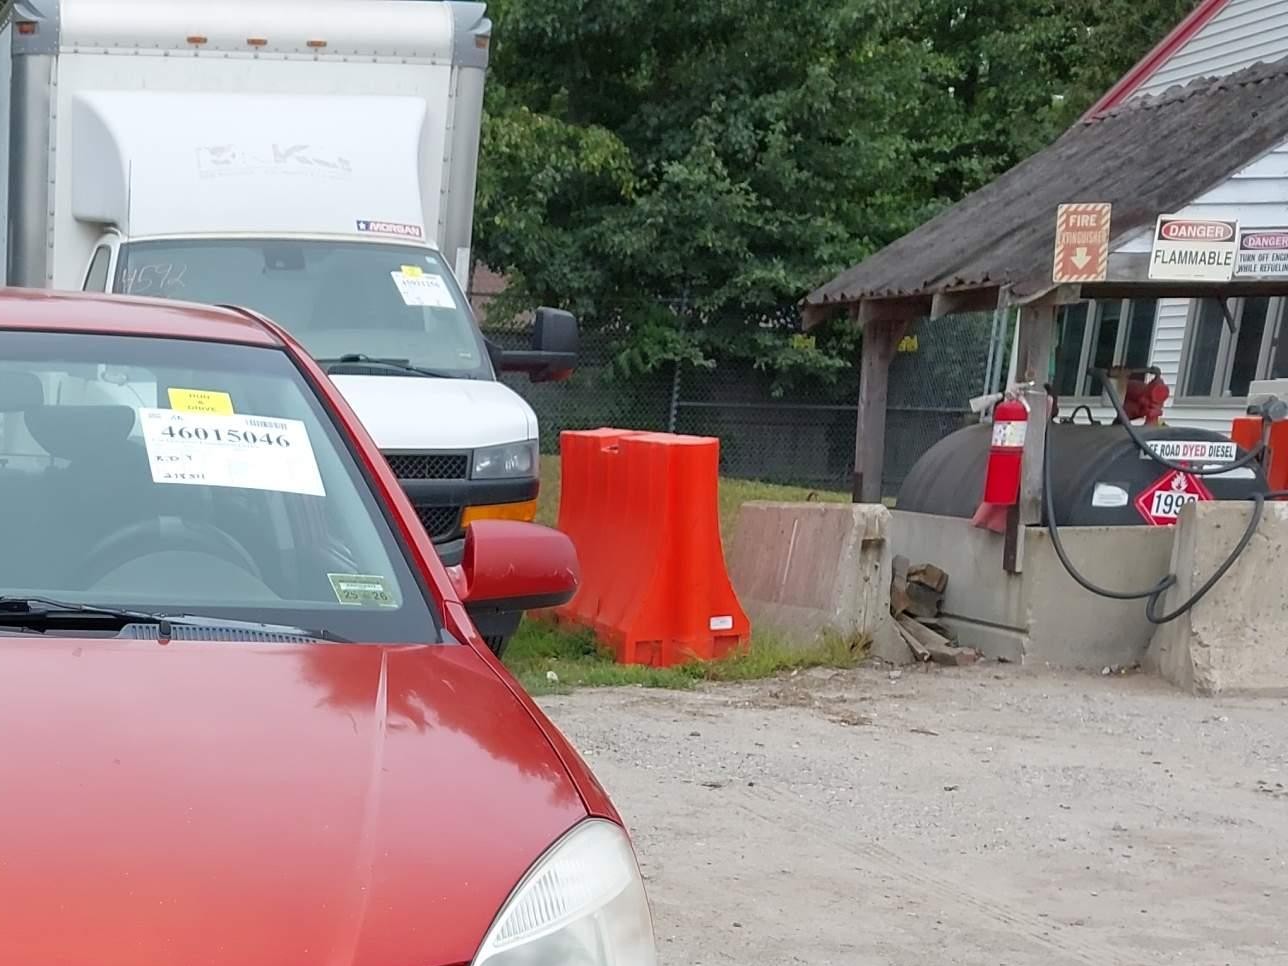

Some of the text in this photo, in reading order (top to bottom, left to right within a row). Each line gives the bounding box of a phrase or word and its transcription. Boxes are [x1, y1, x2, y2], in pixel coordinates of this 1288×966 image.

[1069, 214, 1097, 227] FIRE
[369, 222, 420, 236] MORGAN
[1169, 224, 1225, 238] DANGER
[1153, 250, 1234, 266] FLAMMABLE
[1239, 253, 1256, 262] TURN
[1258, 253, 1269, 262] OFF
[1238, 263, 1257, 272] WHILE
[161, 425, 291, 448] 46015046
[1161, 444, 1180, 457] ROAD
[1182, 444, 1207, 457] DYED
[1208, 444, 1234, 458] DIESEL
